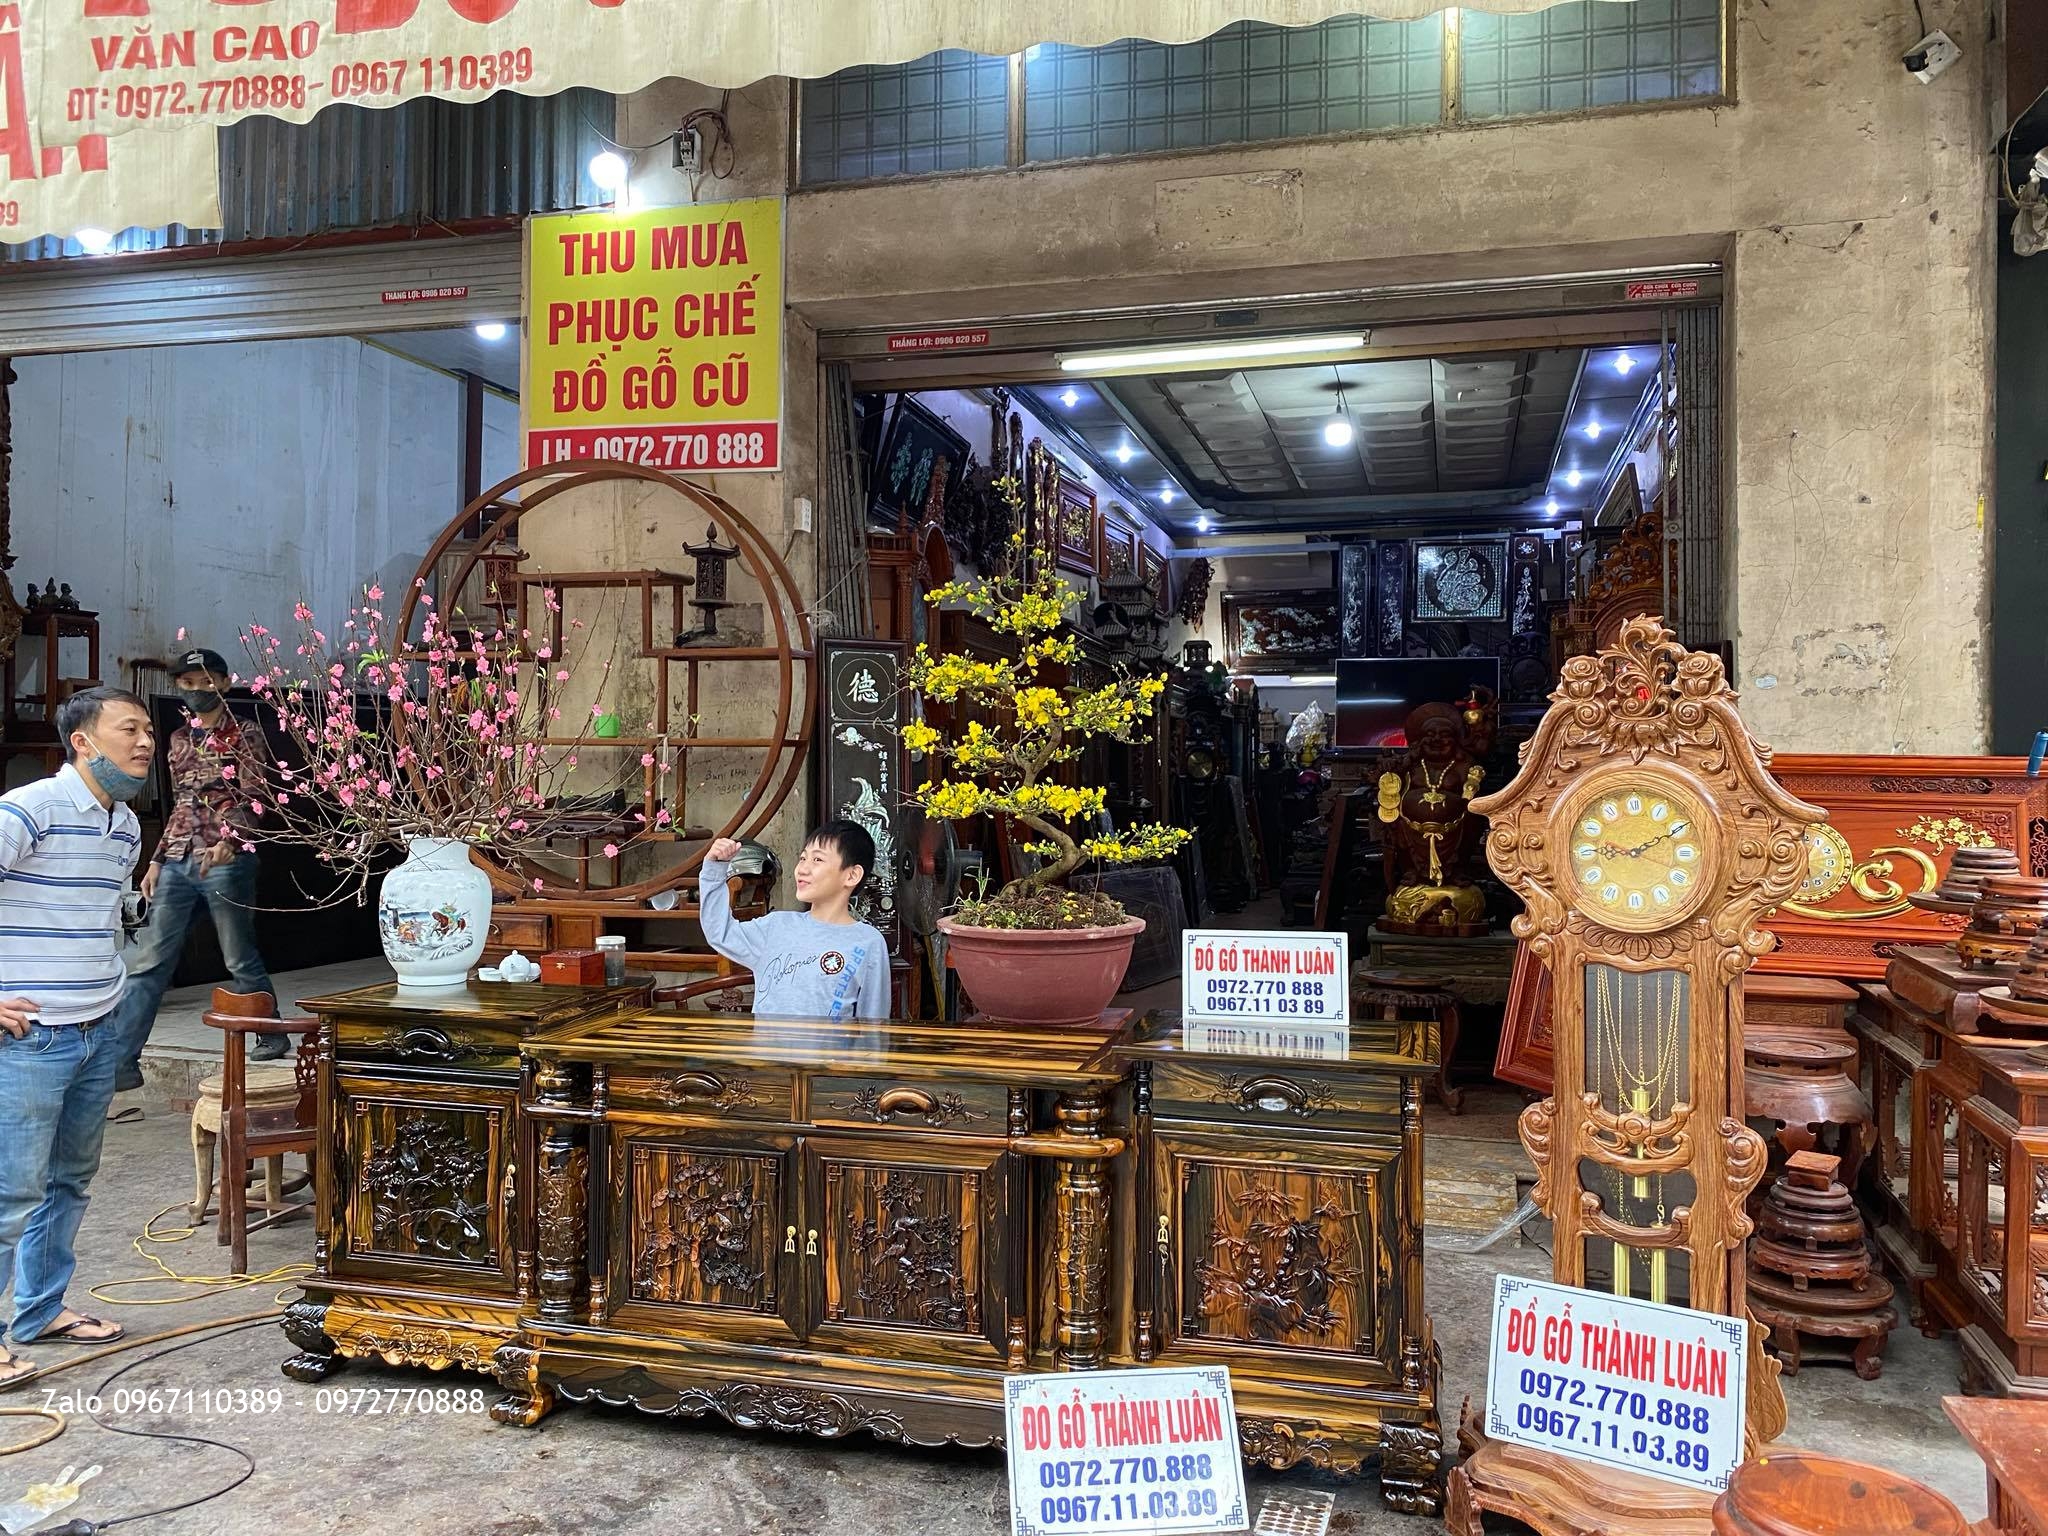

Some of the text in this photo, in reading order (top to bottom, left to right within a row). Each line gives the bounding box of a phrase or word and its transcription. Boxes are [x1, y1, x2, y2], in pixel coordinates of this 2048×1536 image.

[91, 20, 320, 72] VĂN CAO
[331, 60, 408, 98] 0967
[420, 47, 533, 93] 110389
[559, 221, 748, 276] THU MUA
[549, 273, 760, 352] PHỤC CHẾ
[553, 347, 749, 413] ĐỒ GỖ CŨ
[717, 432, 764, 464] 888
[847, 668, 879, 702] 德
[1243, 945, 1291, 973] THÀNH
[1296, 946, 1334, 975] LUÂN
[1207, 979, 1323, 996] 0972.770 888
[1207, 996, 1324, 1014] 0967.11 03 89
[1507, 1297, 1727, 1398] ĐỒ GỖ THÀNH LUÂN
[1058, 1388, 1086, 1449] GỖ
[1091, 1394, 1162, 1447] THÀNH
[1165, 1389, 1223, 1443] LUÂN
[1520, 1368, 1709, 1434] 0972.770.888
[1517, 1402, 1709, 1472] 0967.11.03.89
[1040, 1453, 1213, 1488] 0972.770.888
[1041, 1488, 1217, 1524] 0967.11.03.89
